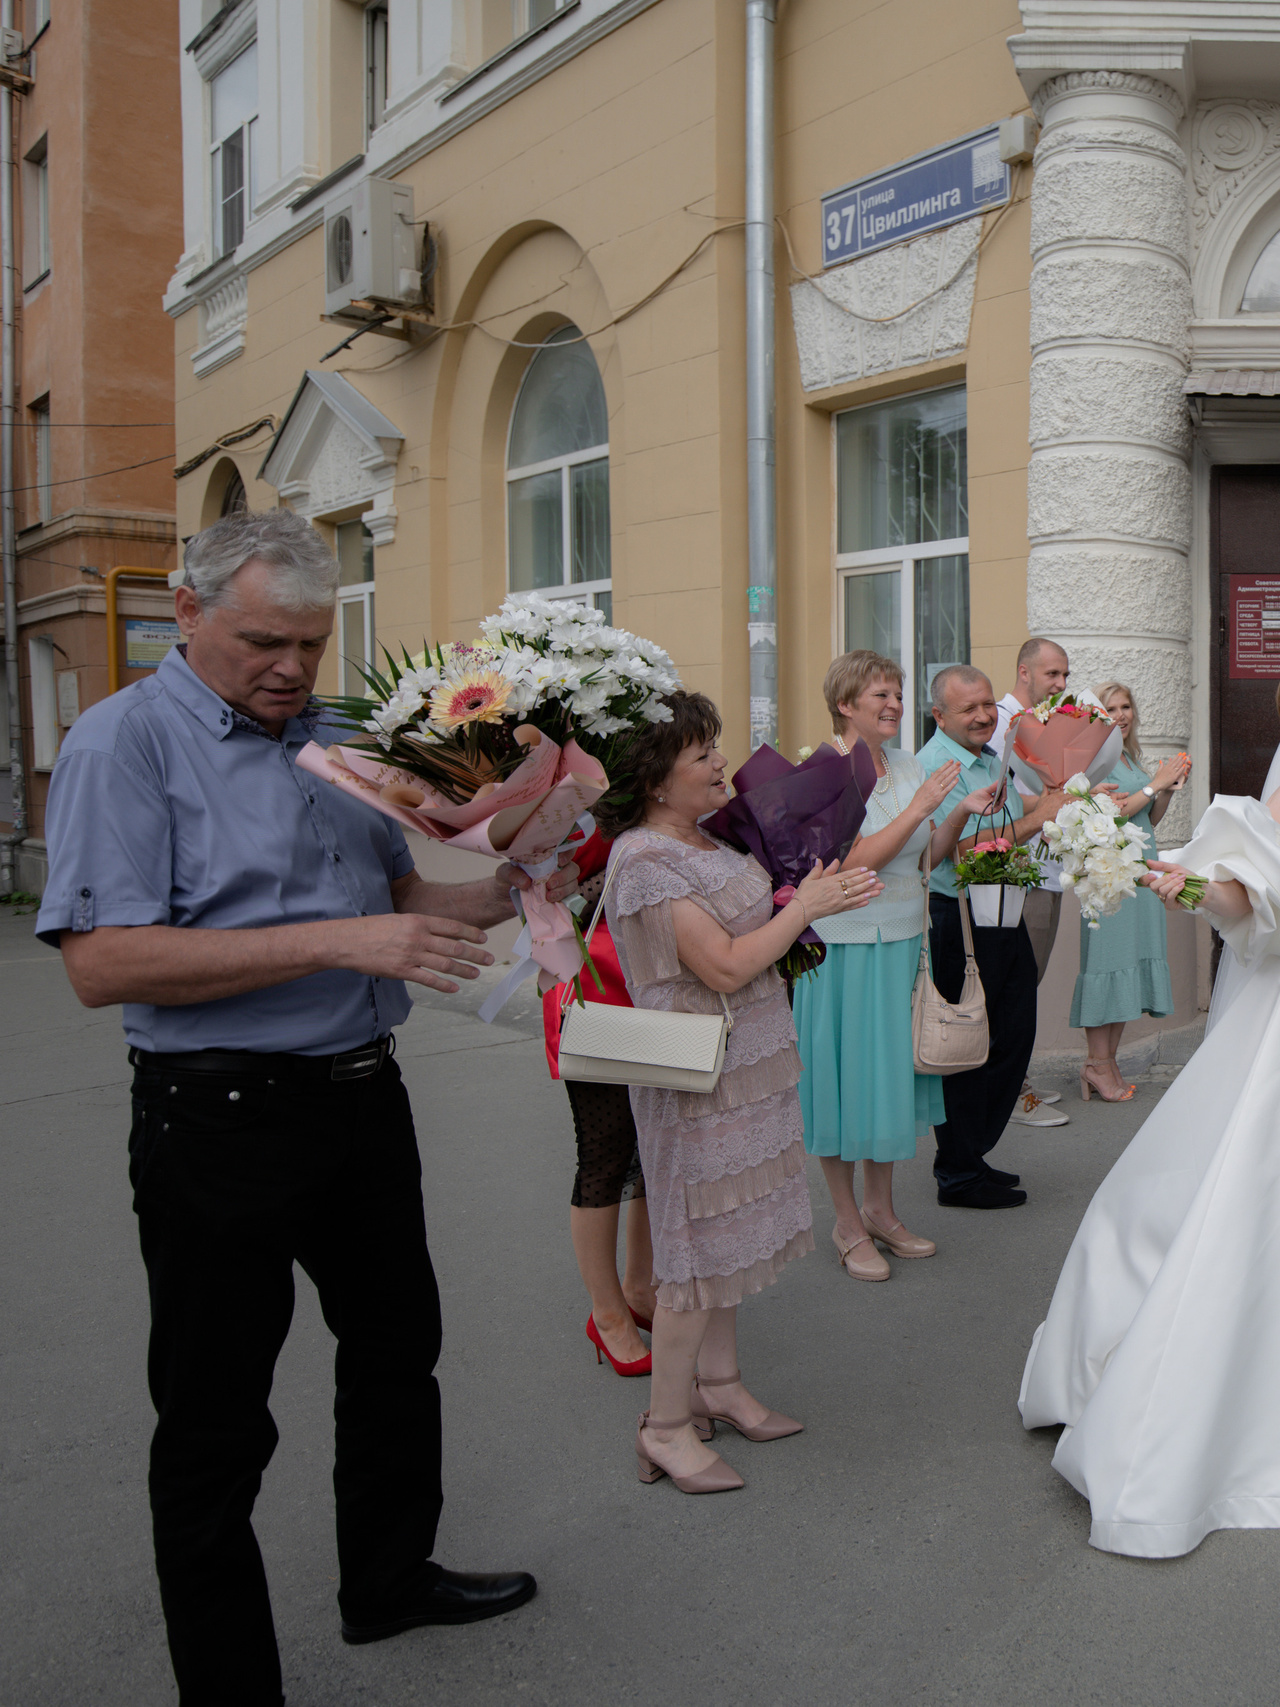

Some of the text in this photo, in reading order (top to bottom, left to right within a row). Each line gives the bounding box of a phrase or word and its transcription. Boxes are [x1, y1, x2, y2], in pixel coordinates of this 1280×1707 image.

[861, 188, 895, 215] улица
[863, 187, 961, 240] Цвиллинга
[827, 204, 856, 251] 37
